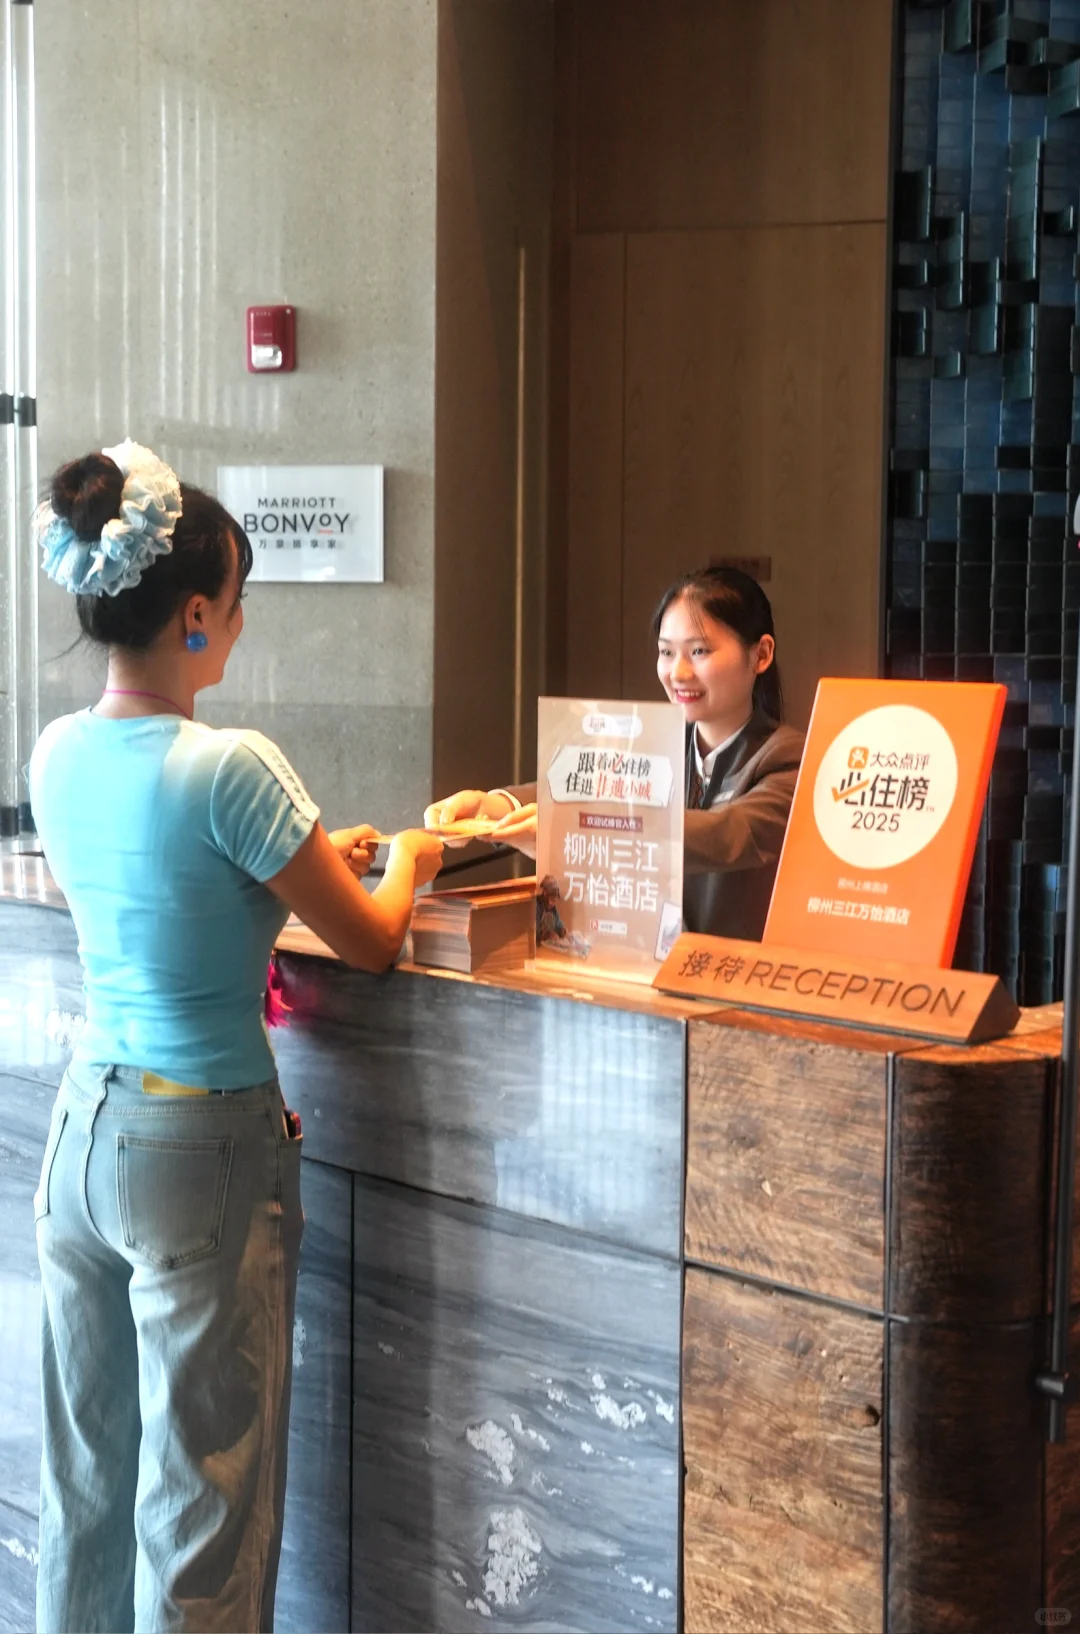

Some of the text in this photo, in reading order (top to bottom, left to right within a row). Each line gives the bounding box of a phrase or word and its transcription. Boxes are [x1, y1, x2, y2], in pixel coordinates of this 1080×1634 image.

[257, 497, 336, 509] MARRIOTT
[243, 513, 350, 533] BONVOY
[577, 752, 652, 779] 跟着必住榜
[869, 751, 931, 771] 大众点评
[831, 772, 931, 812] 必住榜
[850, 811, 901, 833] 2025
[563, 831, 659, 873] 柳州三江
[563, 871, 659, 913] 万怡酒店
[807, 896, 911, 927] 柳州三江万怡酒店
[677, 950, 966, 1018] 接待 RECEPTION
